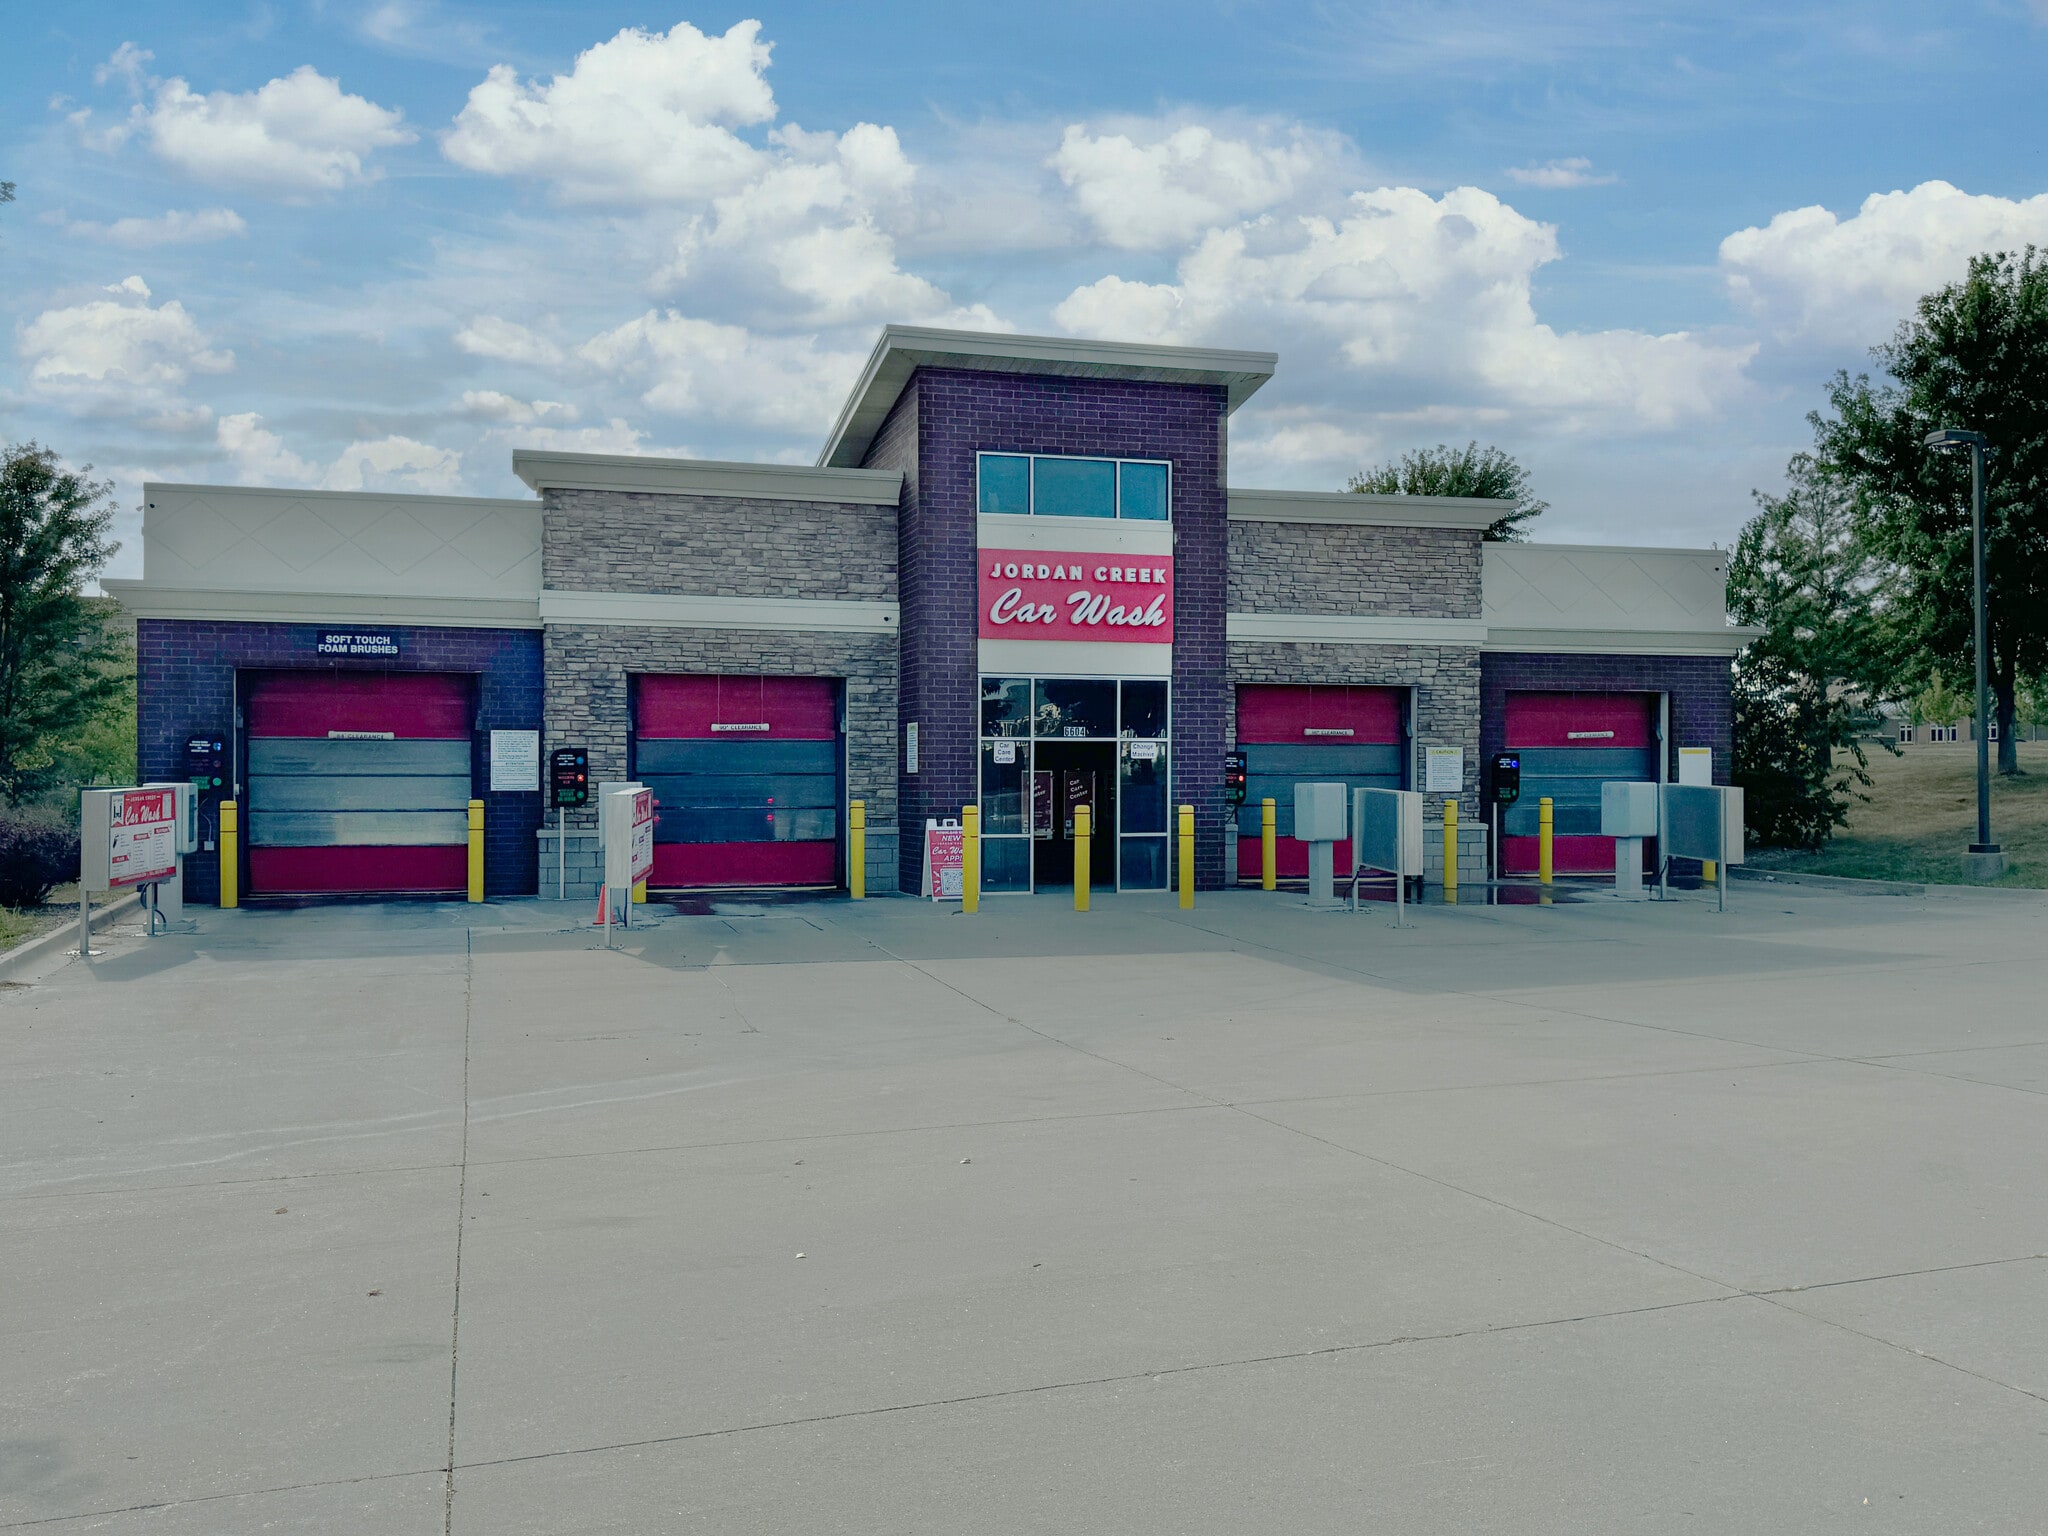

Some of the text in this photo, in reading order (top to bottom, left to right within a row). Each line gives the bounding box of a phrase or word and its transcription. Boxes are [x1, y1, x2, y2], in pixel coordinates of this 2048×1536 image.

[990, 562, 1167, 584] JORDAN CREEK
[989, 587, 1167, 627] Car Wash
[325, 634, 391, 645] SOFT TOUCH
[318, 643, 399, 654] FOAM BRUSHES
[1064, 726, 1086, 736] 6604
[1069, 790, 1088, 800] Center
[126, 804, 160, 825] Car Wash
[932, 847, 948, 855] Car
